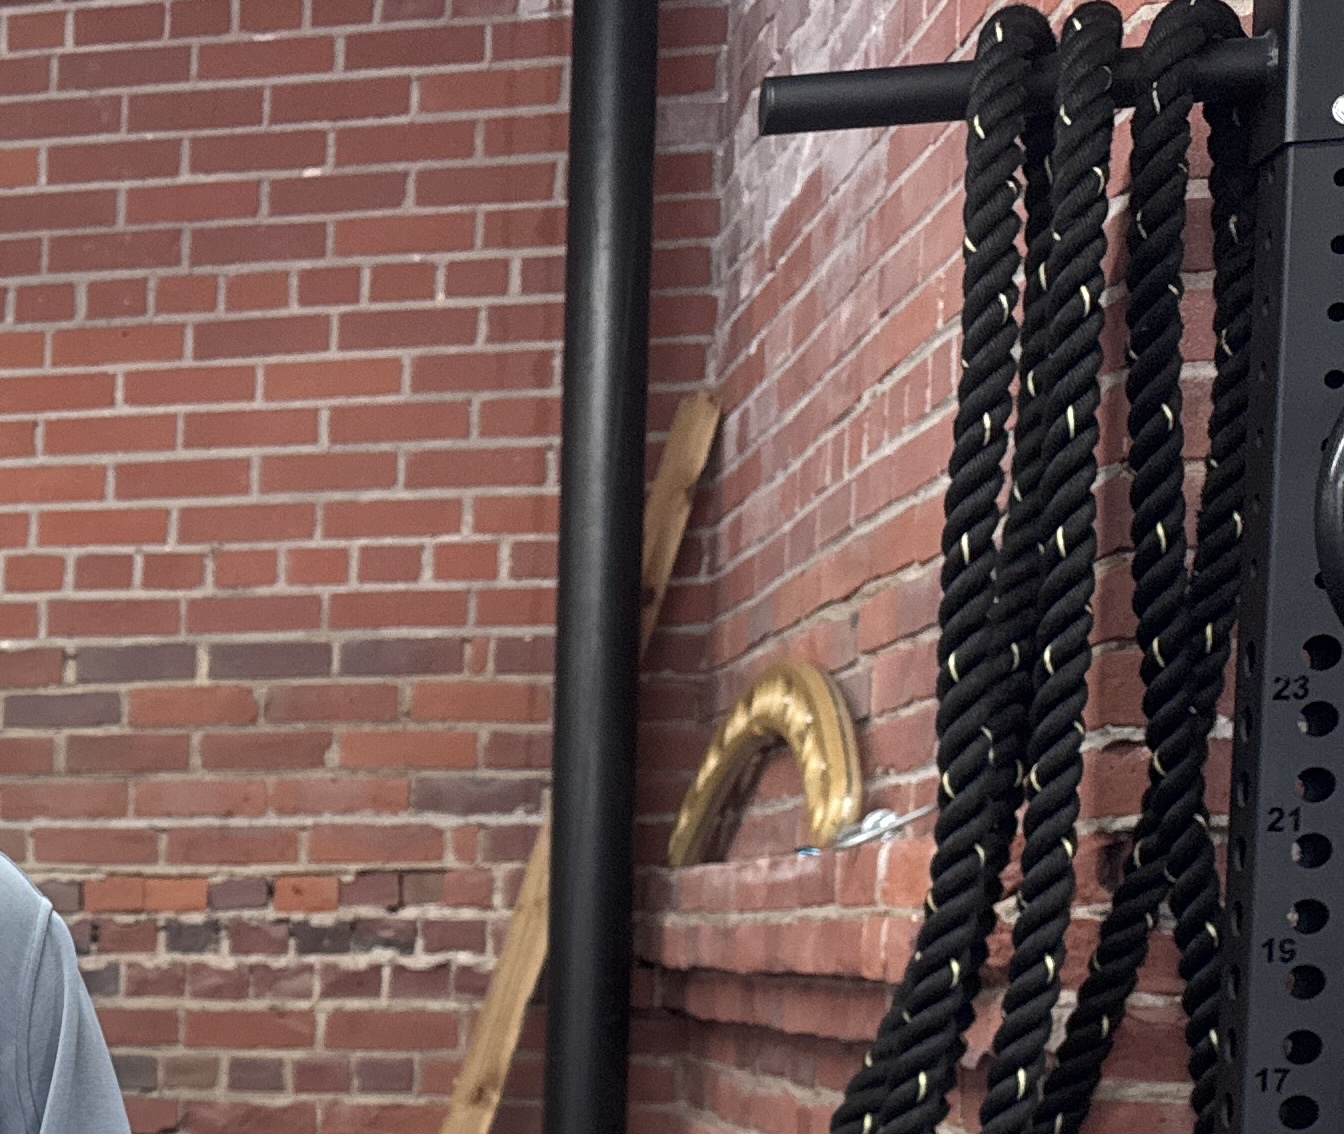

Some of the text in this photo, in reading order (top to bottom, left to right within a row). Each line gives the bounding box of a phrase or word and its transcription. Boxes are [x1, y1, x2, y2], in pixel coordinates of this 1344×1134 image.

[1272, 675, 1309, 701] 23
[1267, 807, 1301, 832] 21
[1261, 938, 1296, 963] 19
[1256, 1067, 1291, 1093] 17
